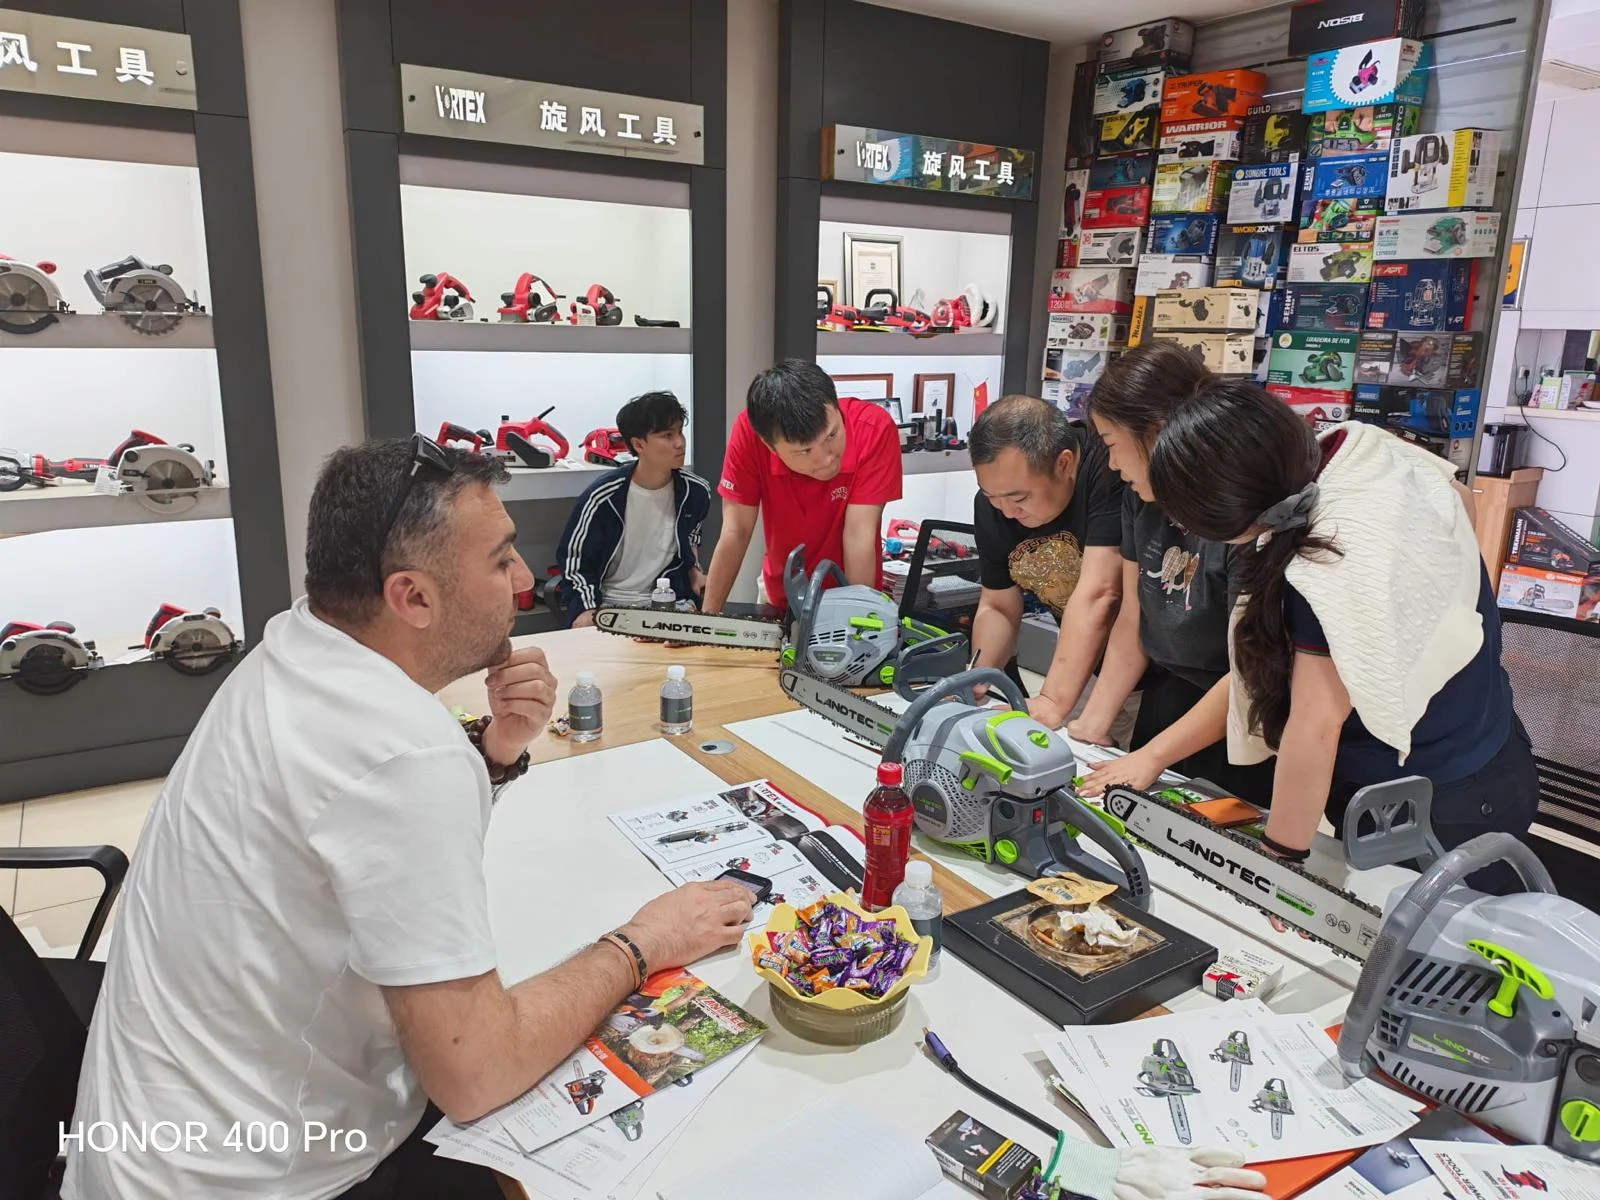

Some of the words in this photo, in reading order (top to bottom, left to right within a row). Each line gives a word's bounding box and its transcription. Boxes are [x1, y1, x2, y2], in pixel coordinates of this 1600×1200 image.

[539, 100, 677, 145] 旋风工具
[1247, 104, 1271, 116] GUILD
[1395, 105, 1404, 139] ERTO
[1165, 120, 1227, 134] WARRIOR
[922, 150, 1014, 186] 旋风工具
[1268, 166, 1287, 177] TOOLS
[642, 620, 712, 635] LANDTEC
[815, 691, 875, 729] LANDTEC
[1166, 828, 1271, 894] LANDTEC
[1433, 1033, 1491, 1064] LANDTEC
[1118, 1098, 1154, 1144] NDTEC
[1462, 1178, 1486, 1200] OWER
